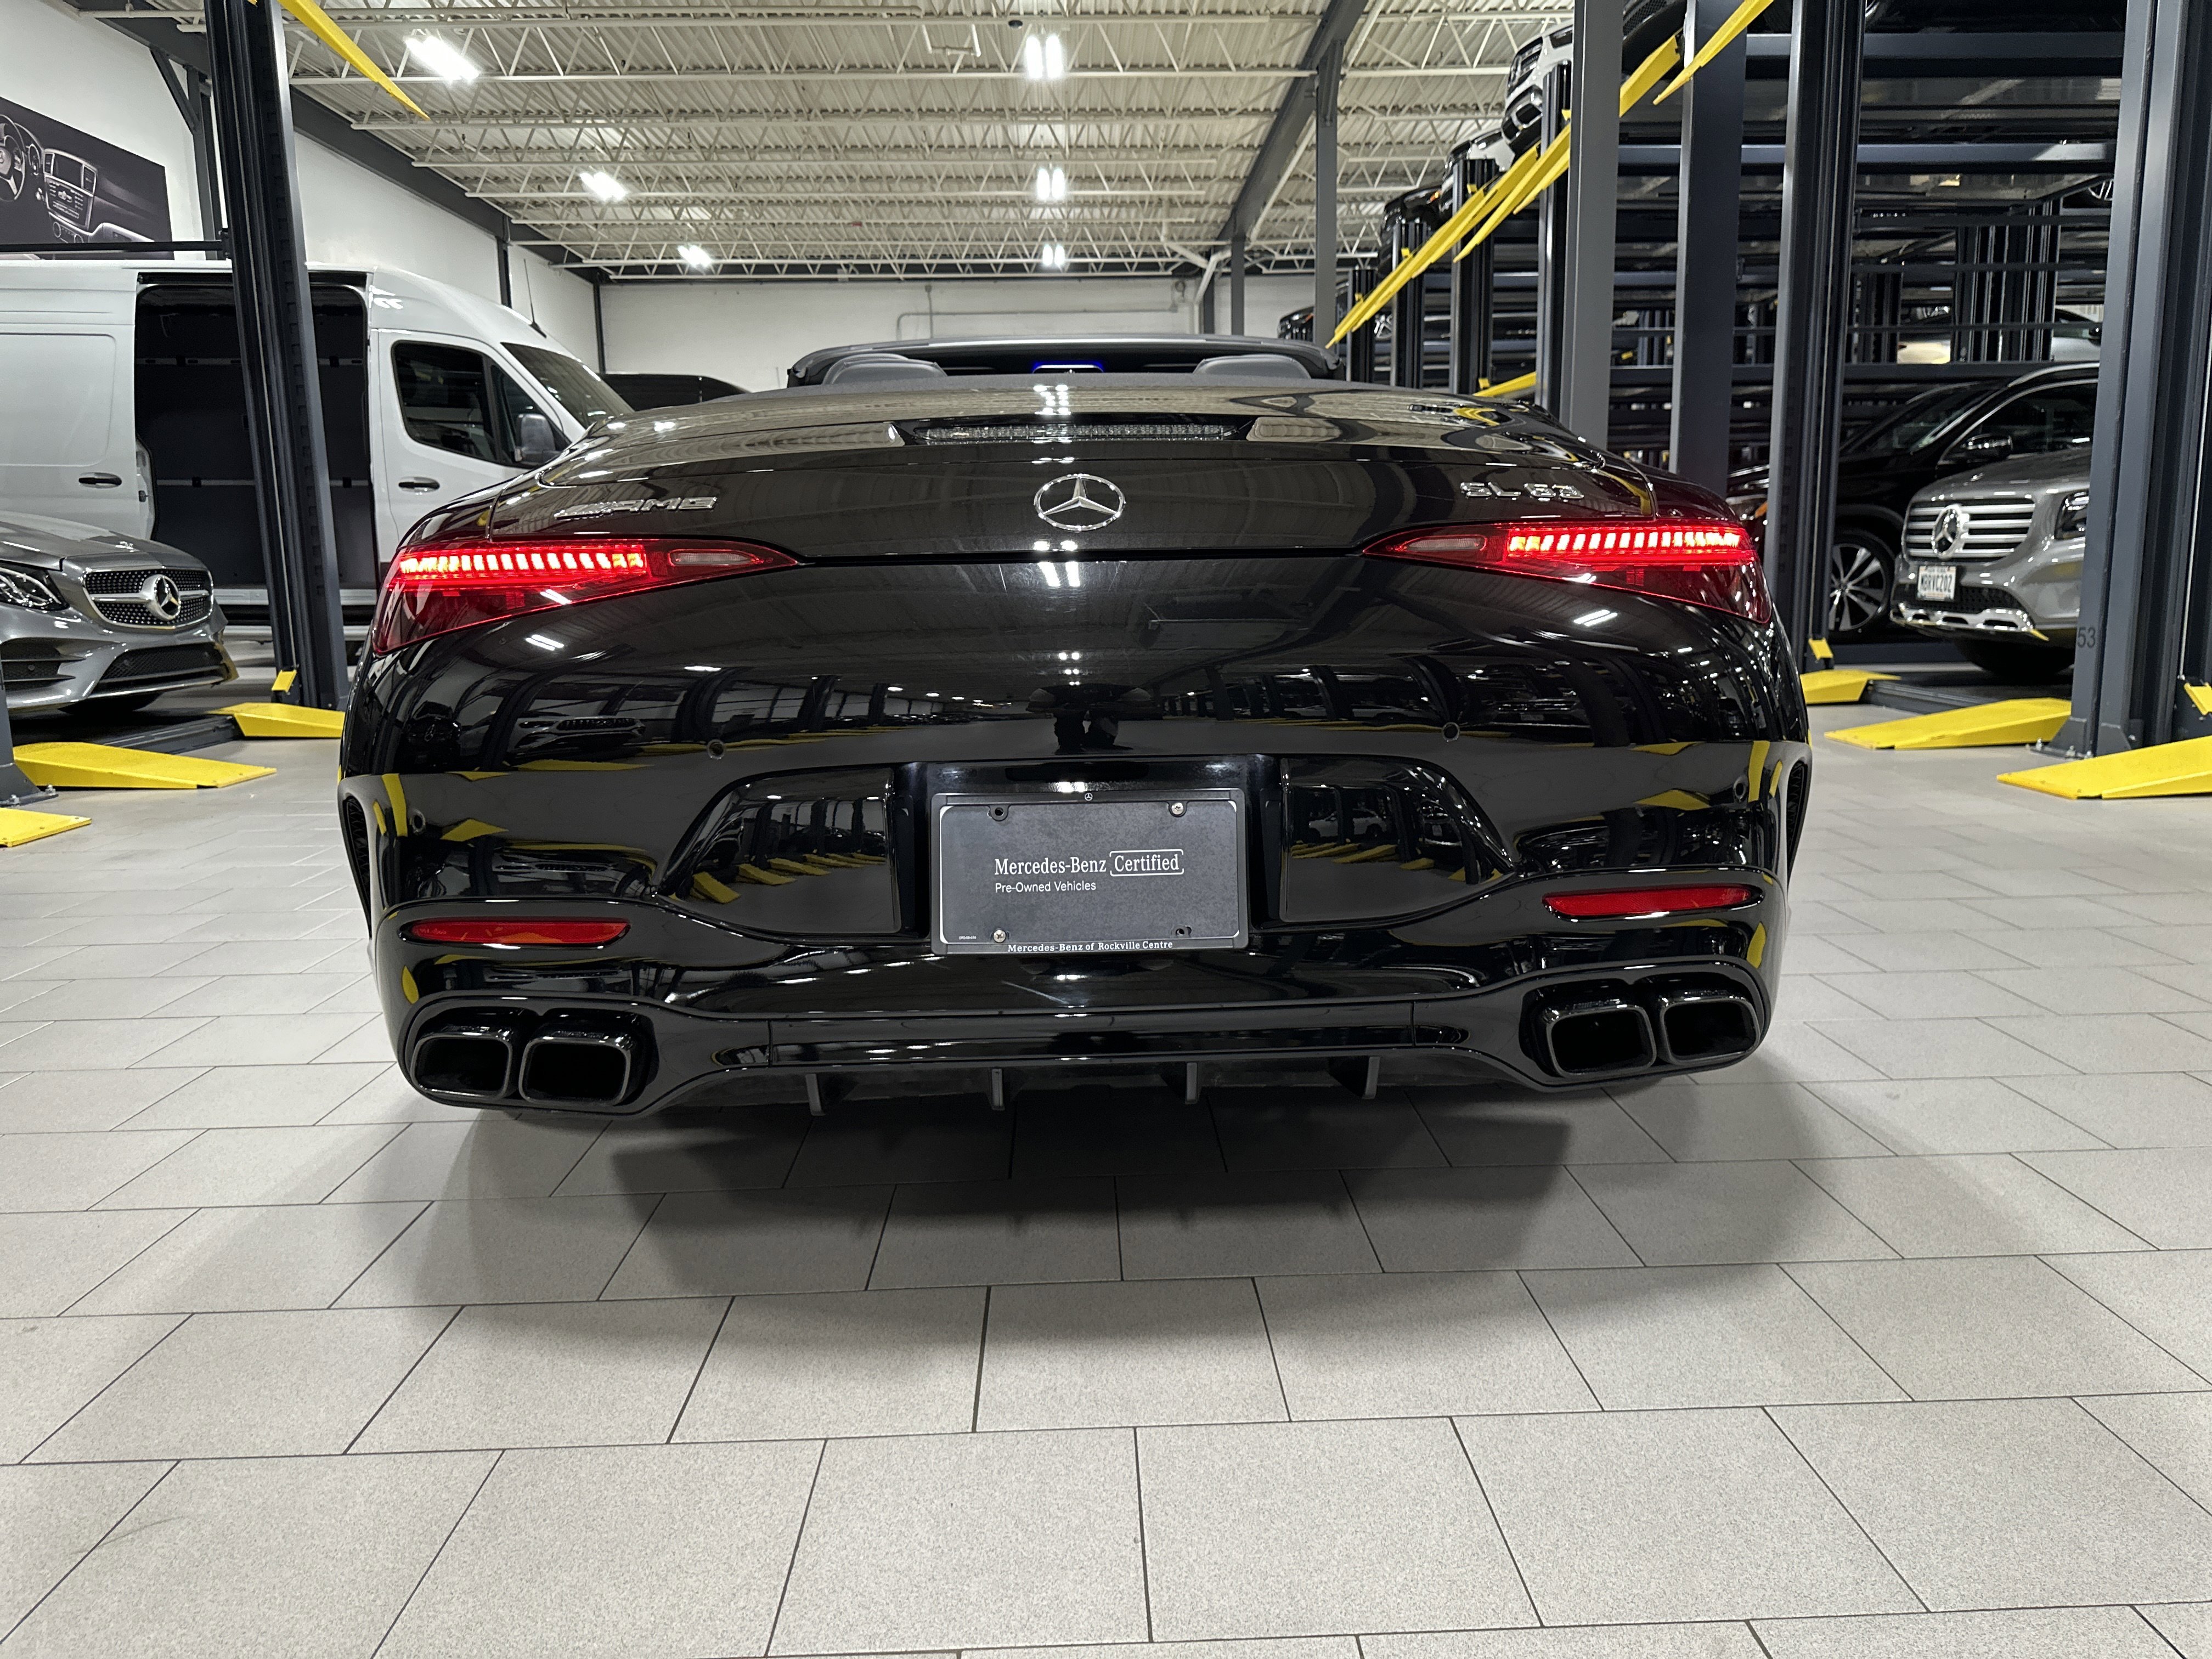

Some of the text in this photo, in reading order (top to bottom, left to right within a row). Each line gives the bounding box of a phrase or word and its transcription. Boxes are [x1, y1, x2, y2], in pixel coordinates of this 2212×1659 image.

[1460, 482, 1521, 498] SL
[596, 496, 718, 514] AMG
[2078, 627, 2096, 648] 53
[994, 854, 1180, 875] Mercedes-Benz Certified
[995, 880, 1096, 893] Pre-Owned Vehicles
[1007, 941, 1173, 952] Mercedes-Benz of Rockville Centre
